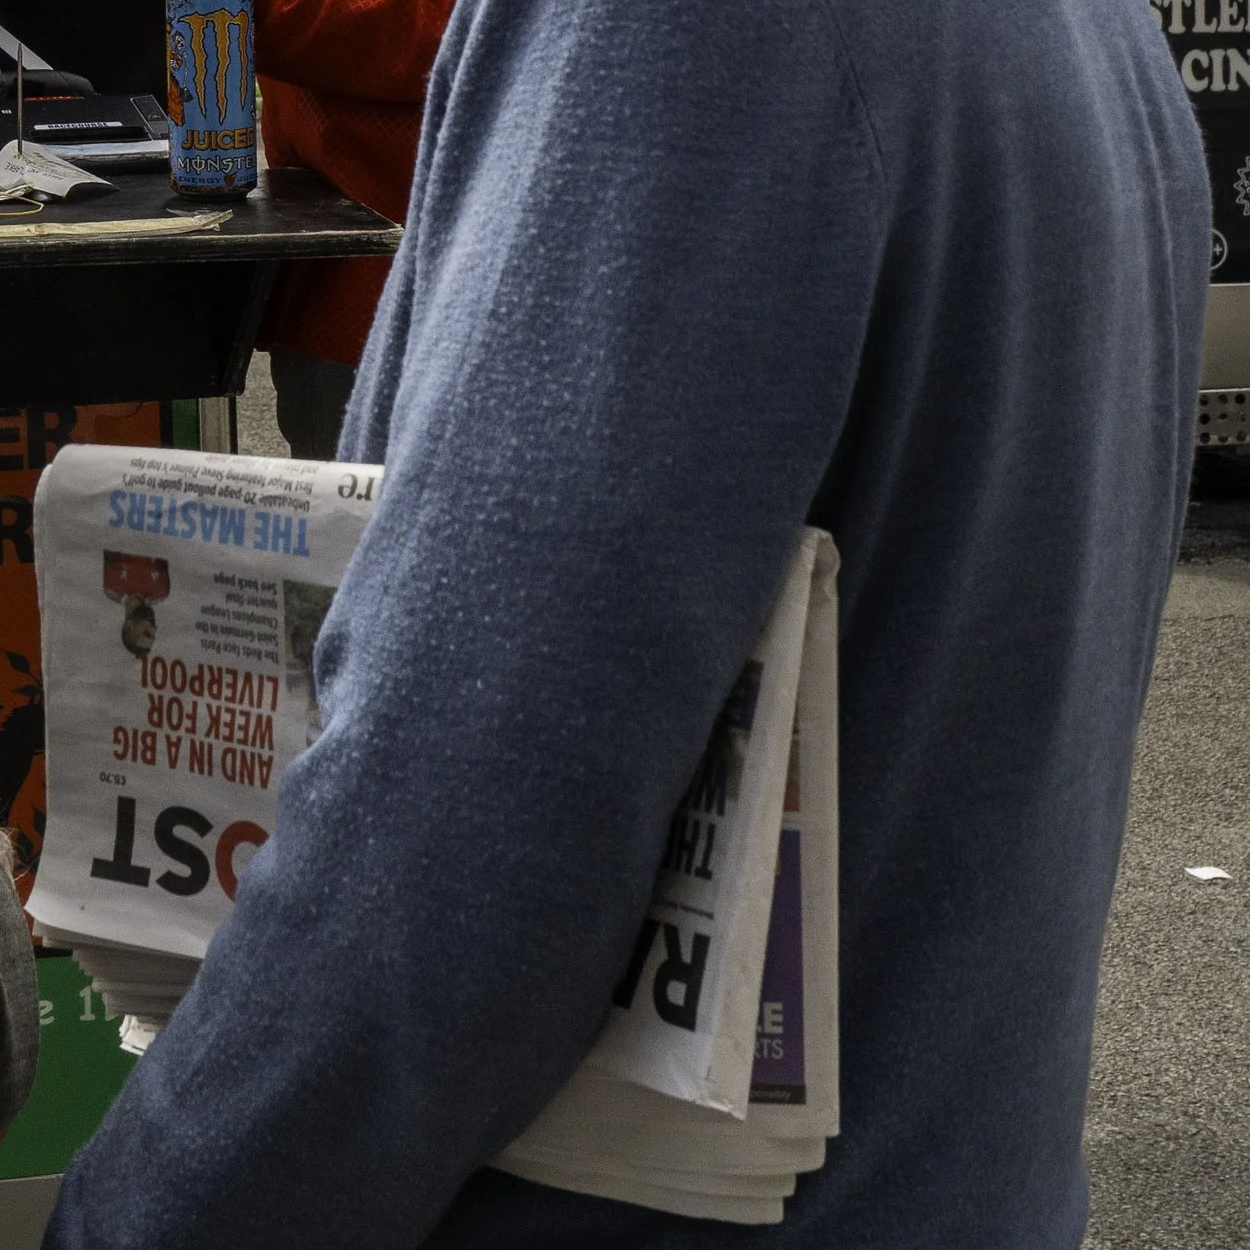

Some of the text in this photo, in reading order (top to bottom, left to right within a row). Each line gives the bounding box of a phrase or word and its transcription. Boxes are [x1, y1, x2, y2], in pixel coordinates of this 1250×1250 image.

[177, 155, 255, 175] MONSTE
[179, 176, 222, 185] ENERGY
[147, 478, 156, 490] to
[157, 478, 182, 492] guide
[183, 482, 216, 498] pullout
[217, 487, 257, 505] 20-page
[258, 493, 310, 513] Unbeatable
[109, 490, 310, 558] THE MASTERS
[138, 656, 279, 711] LIVERPOOL
[147, 693, 275, 751] WEEK FOR
[112, 726, 273, 789] AND IN A BIG
[100, 771, 127, 786] £5.70
